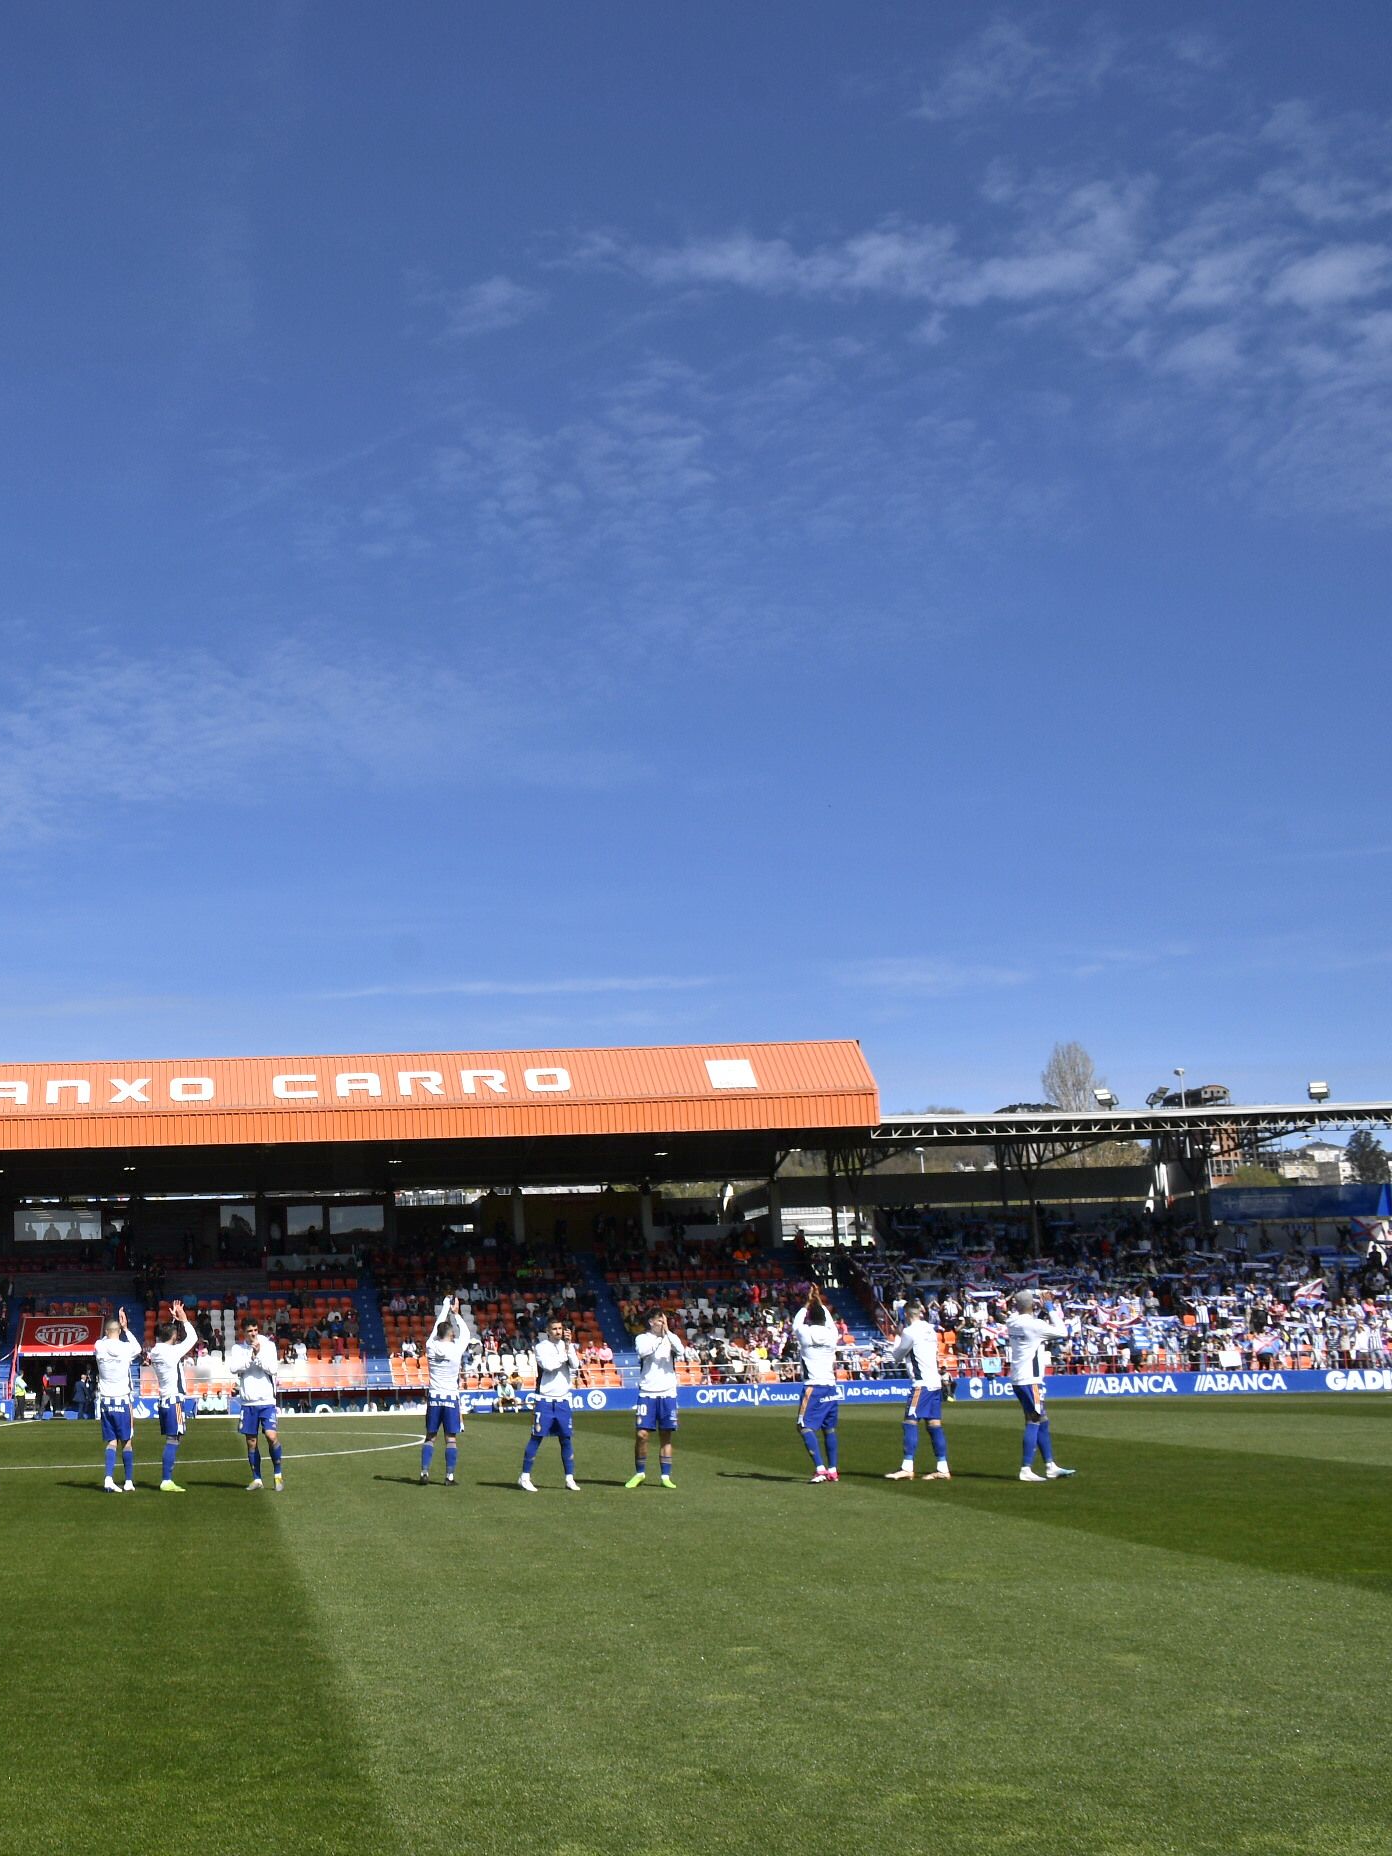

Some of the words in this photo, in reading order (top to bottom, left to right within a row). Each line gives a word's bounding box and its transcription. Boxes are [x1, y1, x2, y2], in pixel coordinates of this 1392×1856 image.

[272, 1067, 571, 1099] CARRO
[1325, 1370, 1392, 1391] GADI
[846, 1387, 860, 1396] AD
[861, 1387, 890, 1398] Grupo
[535, 1411, 541, 1423] 7
